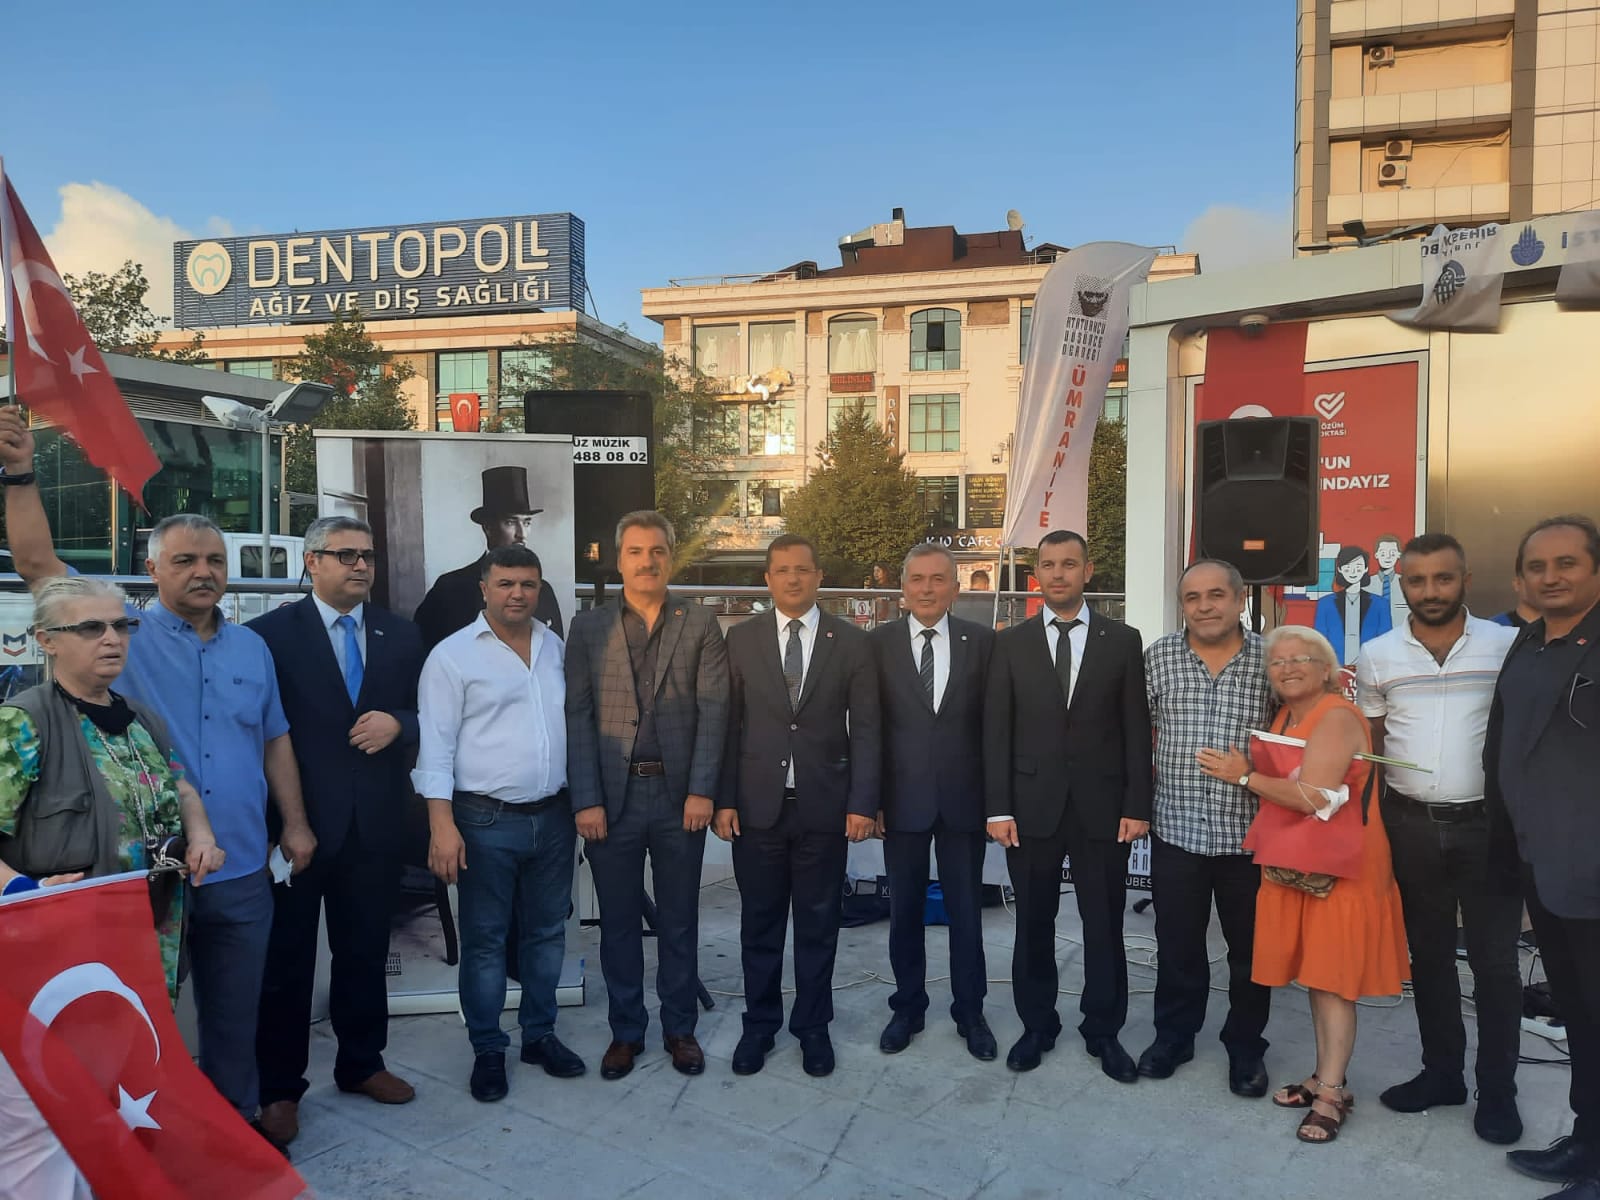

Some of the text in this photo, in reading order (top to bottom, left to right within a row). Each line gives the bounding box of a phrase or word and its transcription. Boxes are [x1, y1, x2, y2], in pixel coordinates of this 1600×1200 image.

[250, 275, 550, 317] AĞIZ VE DİŞ SAĞLIĞI
[592, 438, 630, 448] MÜZİK
[573, 451, 647, 462] 488 08 02
[958, 536, 993, 547] CAFE
